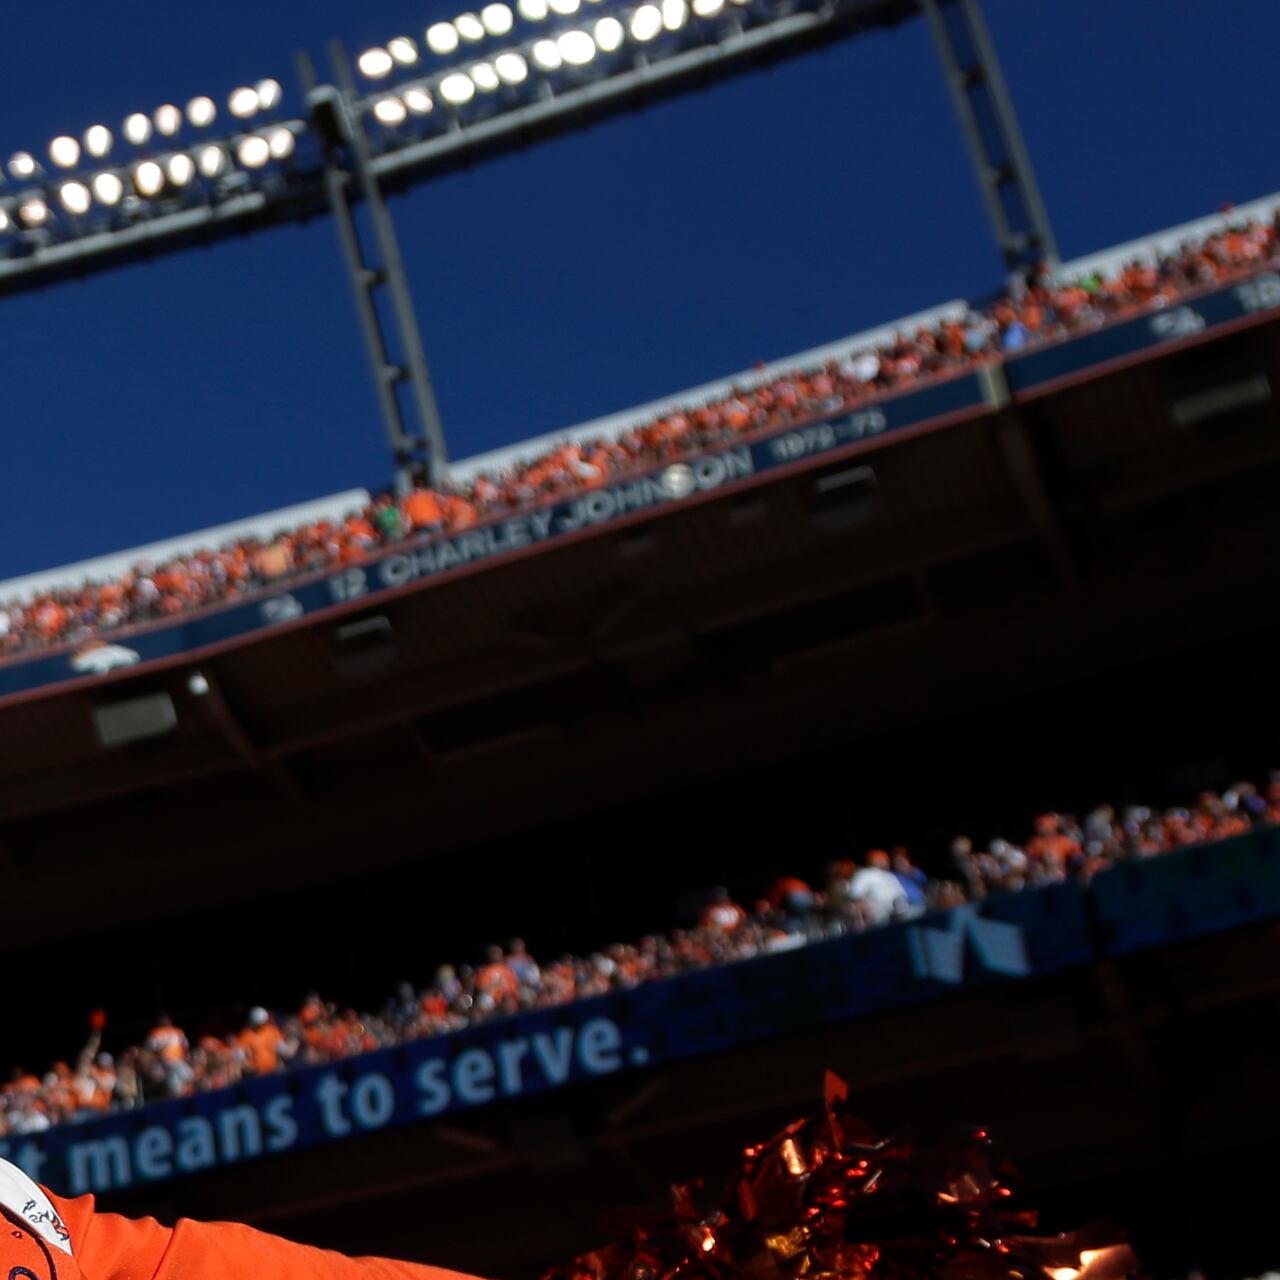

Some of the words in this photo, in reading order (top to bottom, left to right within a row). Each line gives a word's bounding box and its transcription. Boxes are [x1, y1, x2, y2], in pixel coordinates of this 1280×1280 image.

[380, 509, 552, 588] CHARLEY
[562, 449, 754, 532] JOHNON
[67, 1092, 298, 1193] means
[320, 1067, 393, 1136] to
[419, 1017, 650, 1114] serve.
